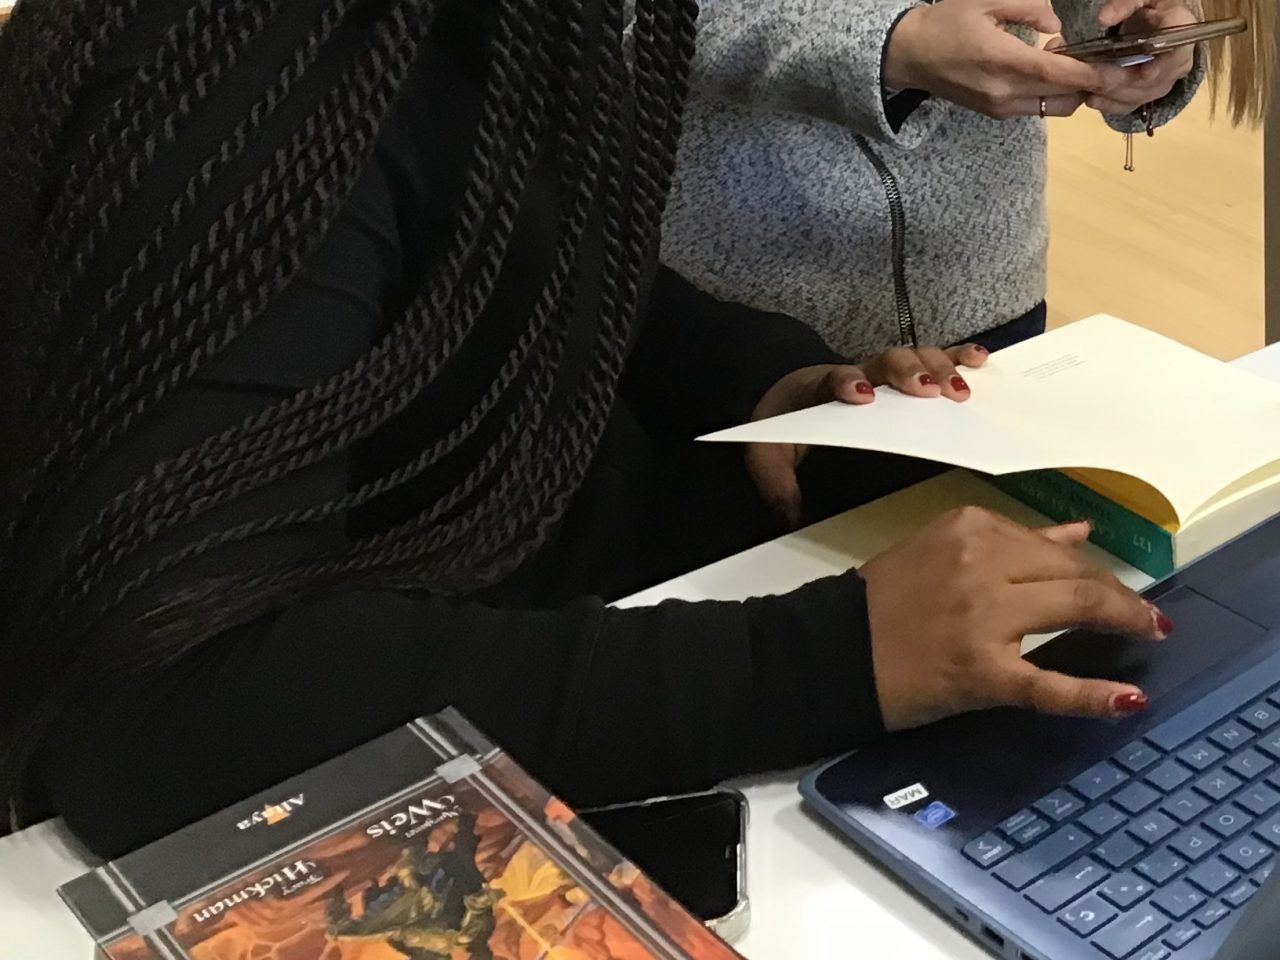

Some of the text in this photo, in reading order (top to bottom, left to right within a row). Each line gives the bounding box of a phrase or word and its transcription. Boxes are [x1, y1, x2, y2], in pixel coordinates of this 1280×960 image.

[236, 793, 305, 831] Altaya
[366, 794, 456, 839] Weis
[888, 788, 923, 807] MAR
[193, 859, 317, 923] Hickman
